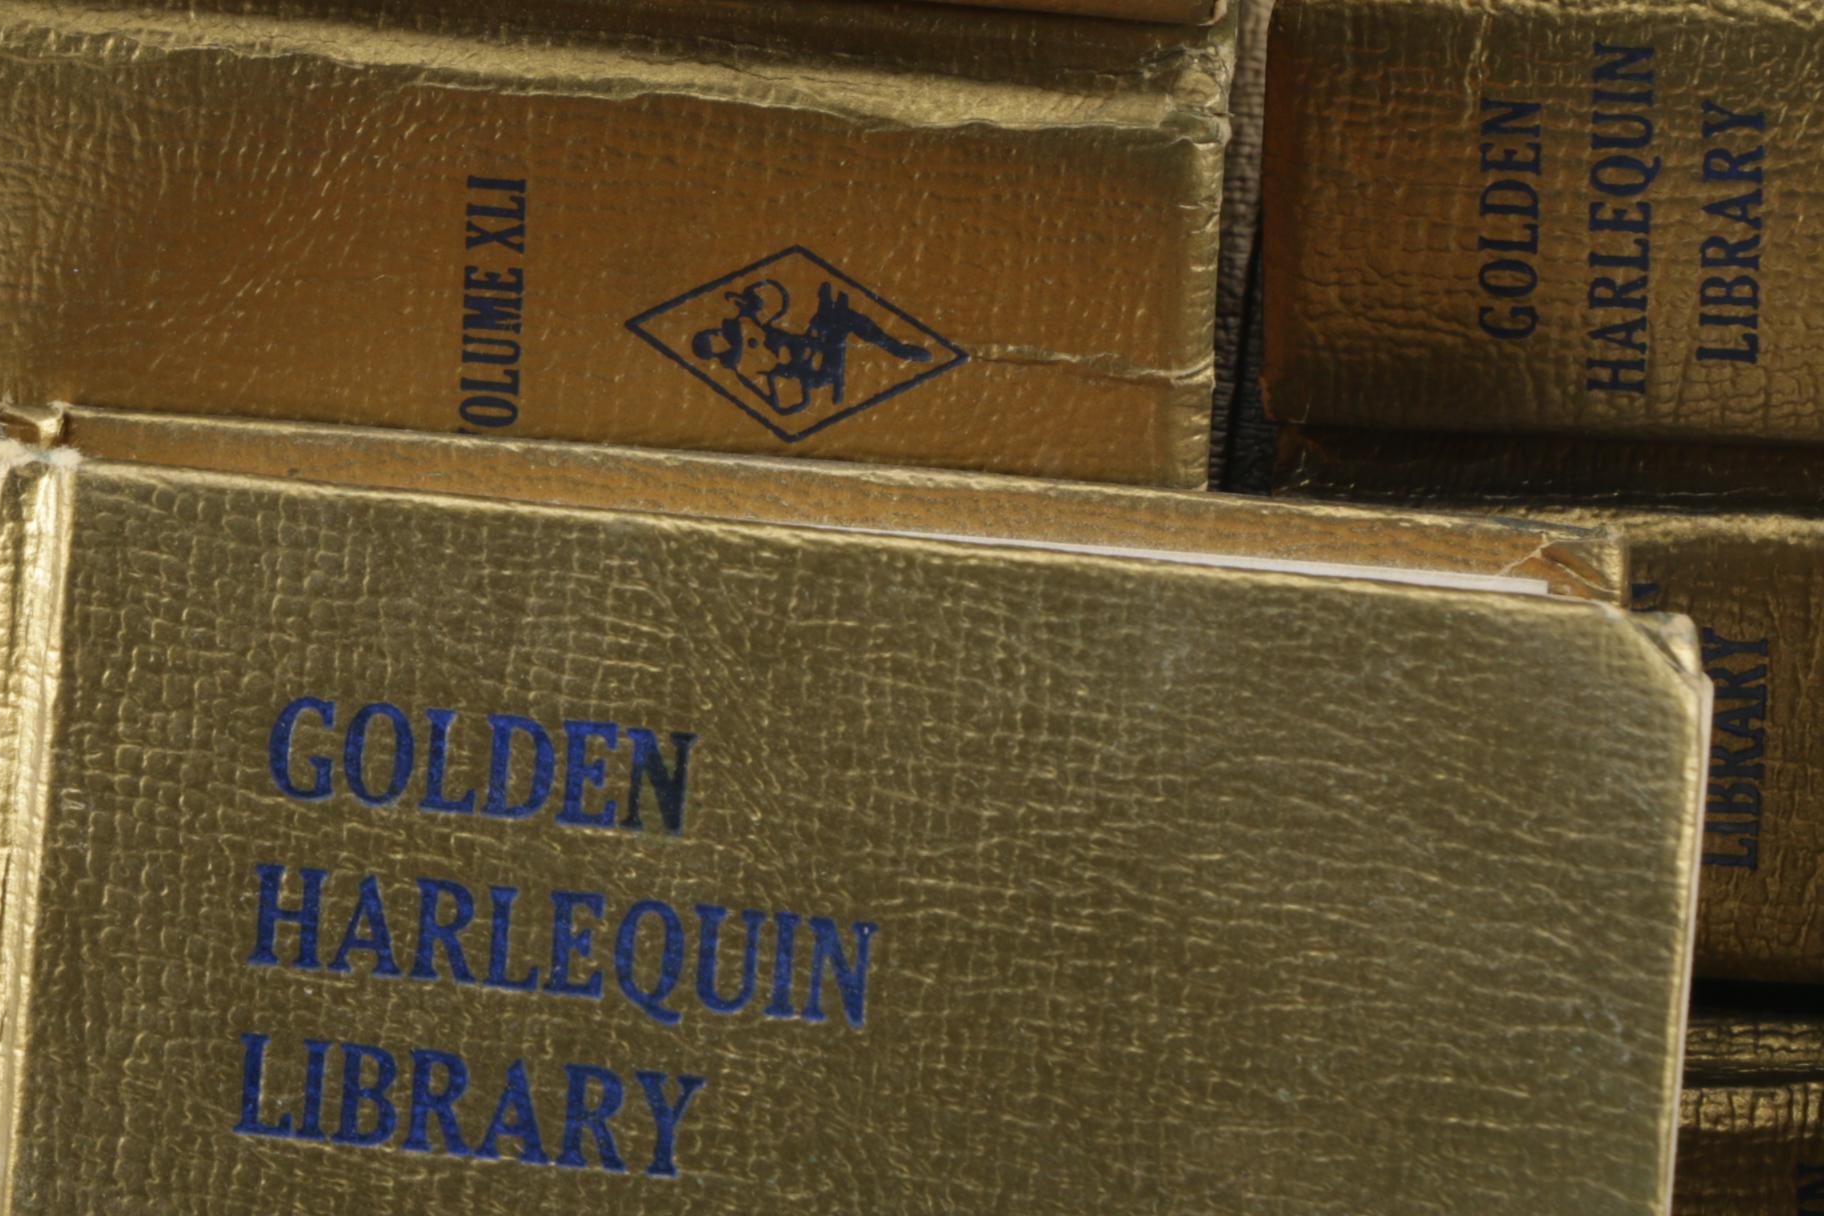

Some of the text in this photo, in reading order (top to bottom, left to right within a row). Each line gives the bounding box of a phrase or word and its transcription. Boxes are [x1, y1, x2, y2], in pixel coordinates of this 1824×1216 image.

[456, 176, 527, 436] OLUME XLI
[1477, 97, 1543, 342] GOLDEN
[1584, 40, 1662, 395] HARLEQUIN
[1696, 98, 1768, 363] LIBRARY
[268, 696, 696, 835] GOLDEN
[1701, 628, 1770, 871] LIBRARY
[241, 864, 878, 1029] HARLEQUIN
[233, 1033, 705, 1178] LIBRARY
